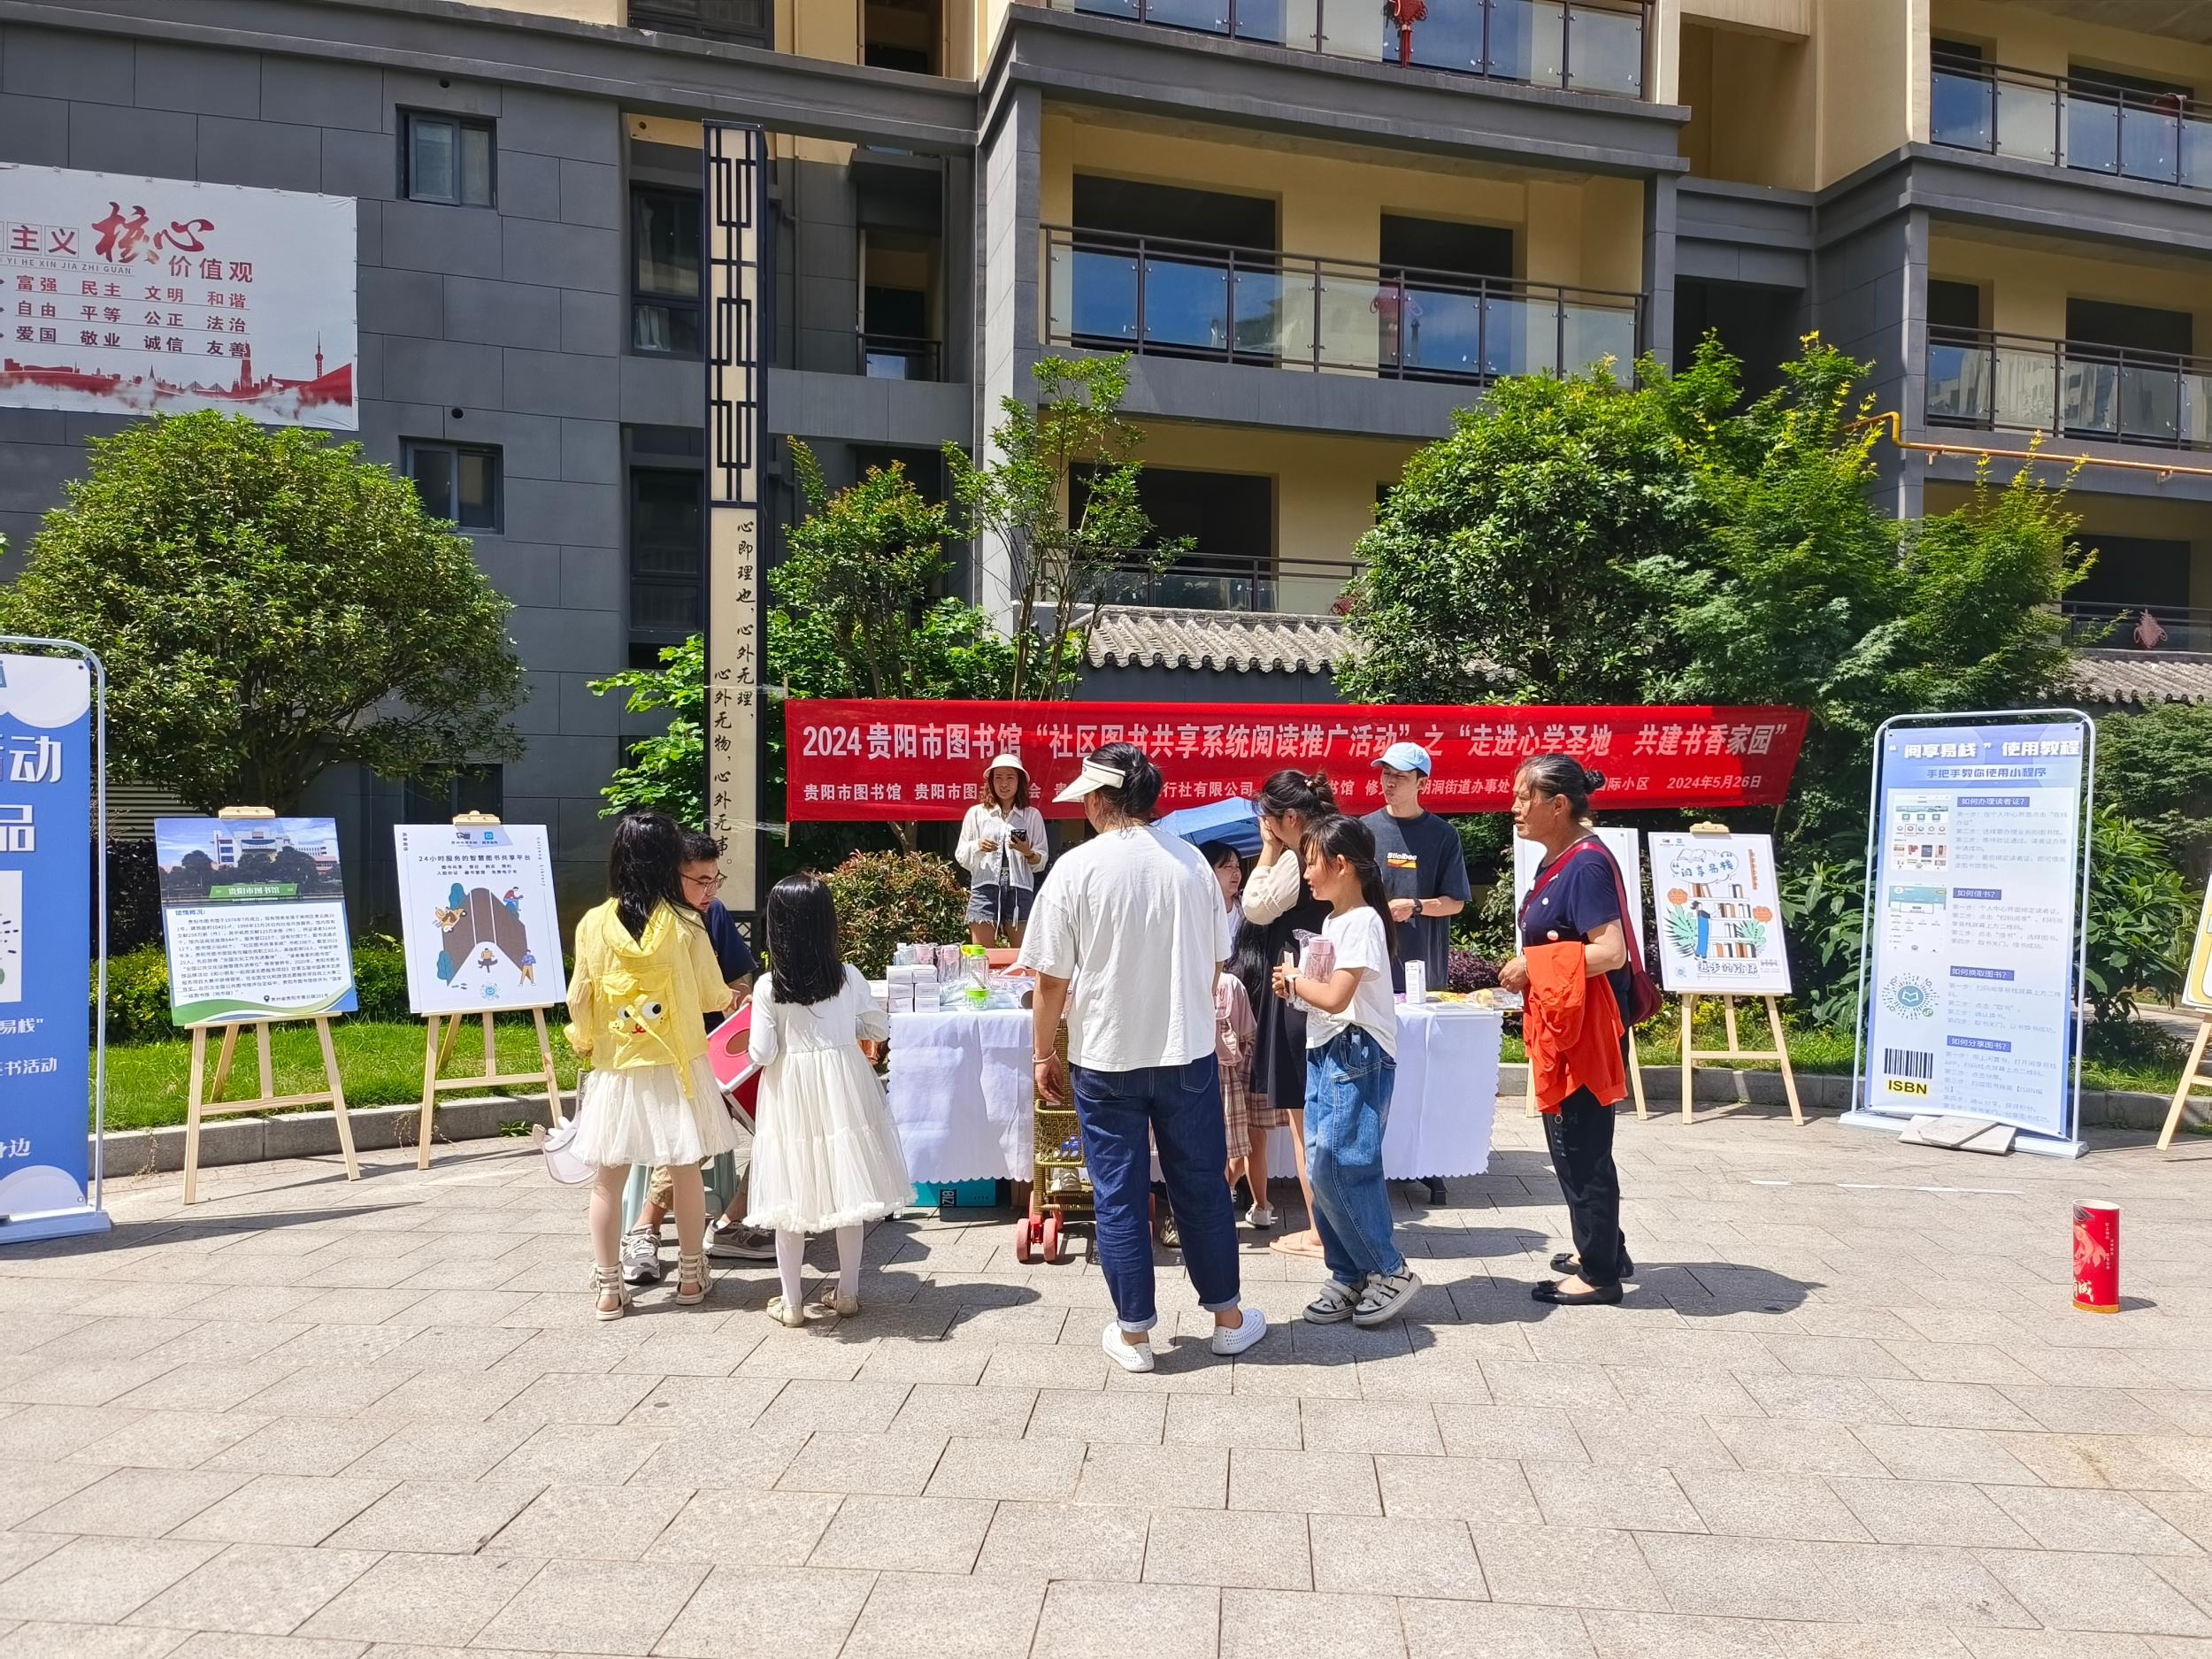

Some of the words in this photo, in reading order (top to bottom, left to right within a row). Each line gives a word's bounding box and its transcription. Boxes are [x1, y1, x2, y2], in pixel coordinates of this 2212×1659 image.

[11, 225, 77, 256] 主义
[91, 201, 215, 265] 核心
[61, 261, 78, 270] JIA
[104, 265, 132, 274] GUAN
[169, 255, 253, 283] 价值观
[17, 275, 58, 293] 富强
[81, 280, 121, 297] 民主
[144, 285, 184, 303] 文明
[207, 290, 246, 309] 和谐
[18, 300, 56, 318] 自由
[81, 304, 120, 322] 平等
[144, 311, 184, 327] 公正
[207, 315, 246, 333] 法治
[16, 325, 57, 342] 爱国
[80, 330, 120, 347] 敬业
[143, 334, 184, 353] 诚信
[207, 340, 246, 358] 友善
[0, 733, 63, 784] 动
[2001, 740, 2081, 757] 使用教程
[1926, 767, 2047, 779] 手把手教你使用小程序
[803, 783, 902, 801] 贵阳市图书馆
[1159, 780, 1254, 798] 行社有限公司
[1666, 774, 1763, 789] 2024年5月26日
[419, 854, 532, 863] 24小时服务的智慧图书共享平台
[0, 1056, 58, 1076] 书活动
[1887, 1079, 1928, 1095] ISBN
